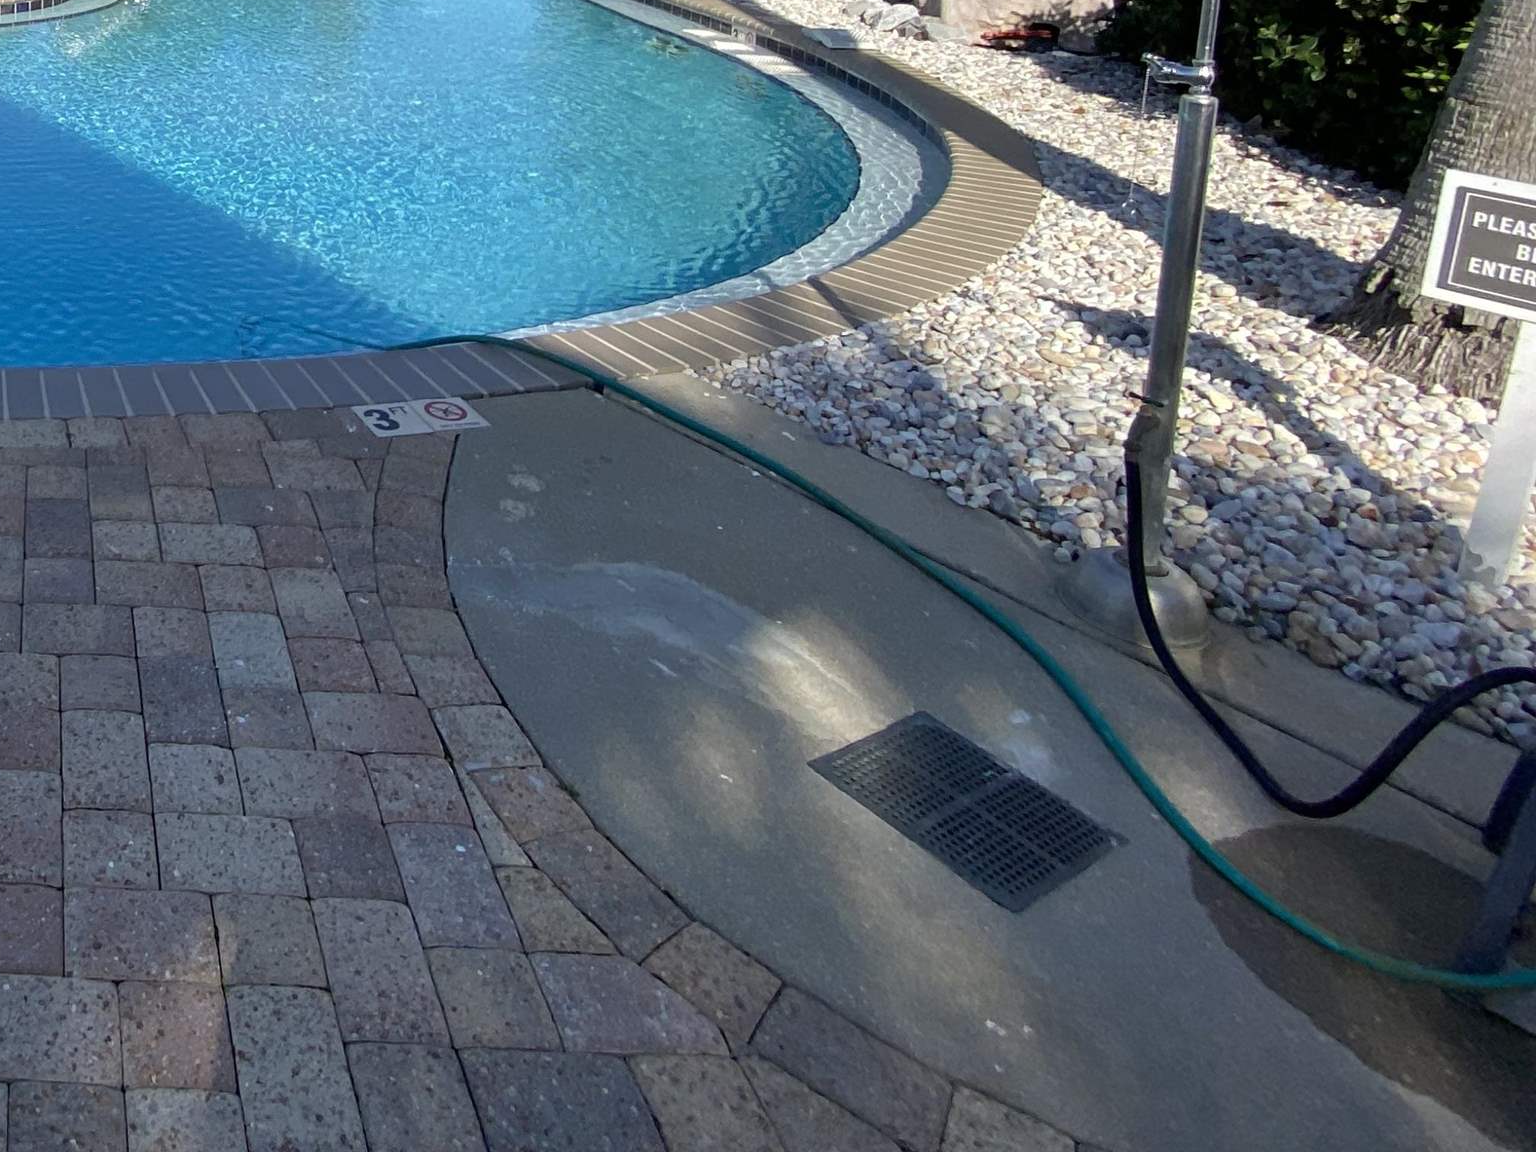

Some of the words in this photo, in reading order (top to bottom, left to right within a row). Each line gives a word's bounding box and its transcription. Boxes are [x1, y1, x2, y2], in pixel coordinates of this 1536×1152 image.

[1472, 211, 1536, 240] PLEAS
[1468, 256, 1536, 288] ENTER
[364, 409, 400, 431] 3
[388, 406, 407, 415] FT
